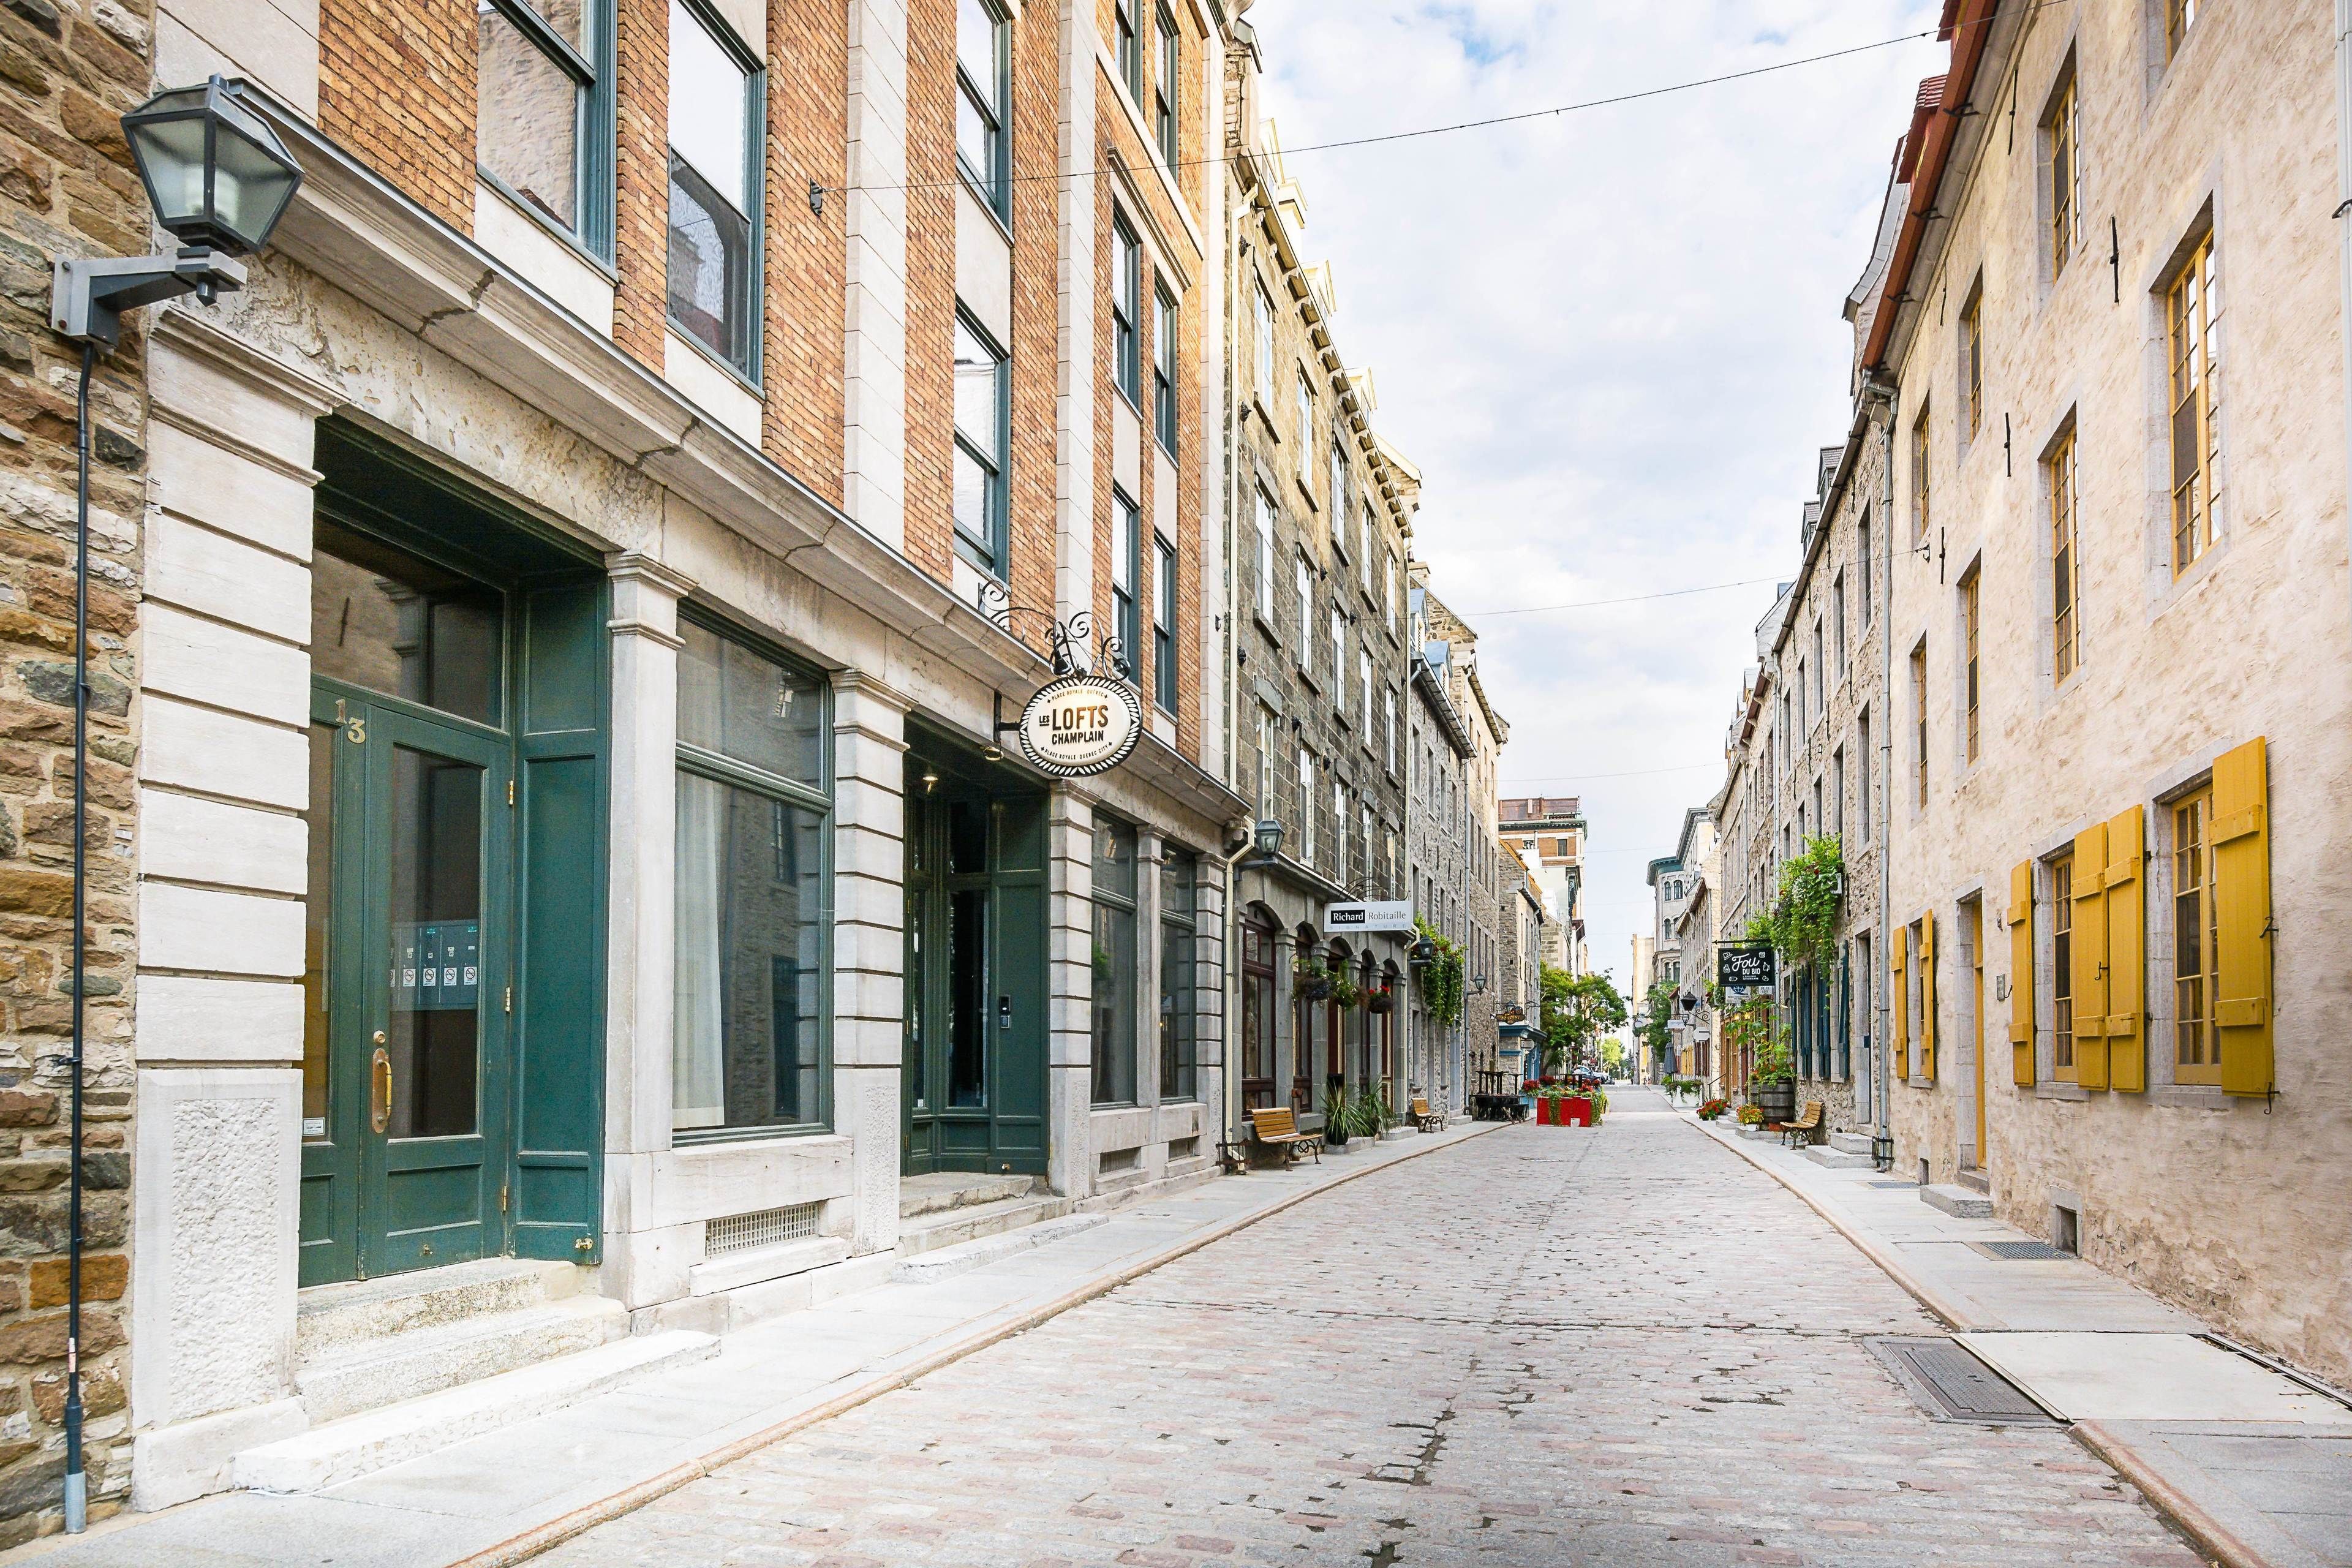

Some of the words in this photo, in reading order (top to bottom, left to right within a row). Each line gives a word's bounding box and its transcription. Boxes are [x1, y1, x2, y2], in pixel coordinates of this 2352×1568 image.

[1052, 692, 1065, 701] PLACE
[335, 699, 366, 744] 13
[1039, 715, 1050, 723] LES
[1052, 704, 1109, 731] LOFTS
[1052, 730, 1104, 745] CHAMPLAIN
[1044, 748, 1058, 758] PLACE
[1080, 750, 1097, 759] QUEBEC
[1333, 912, 1363, 921] Richard
[1368, 911, 1406, 920] Robitaille
[1732, 953, 1760, 971] Fou
